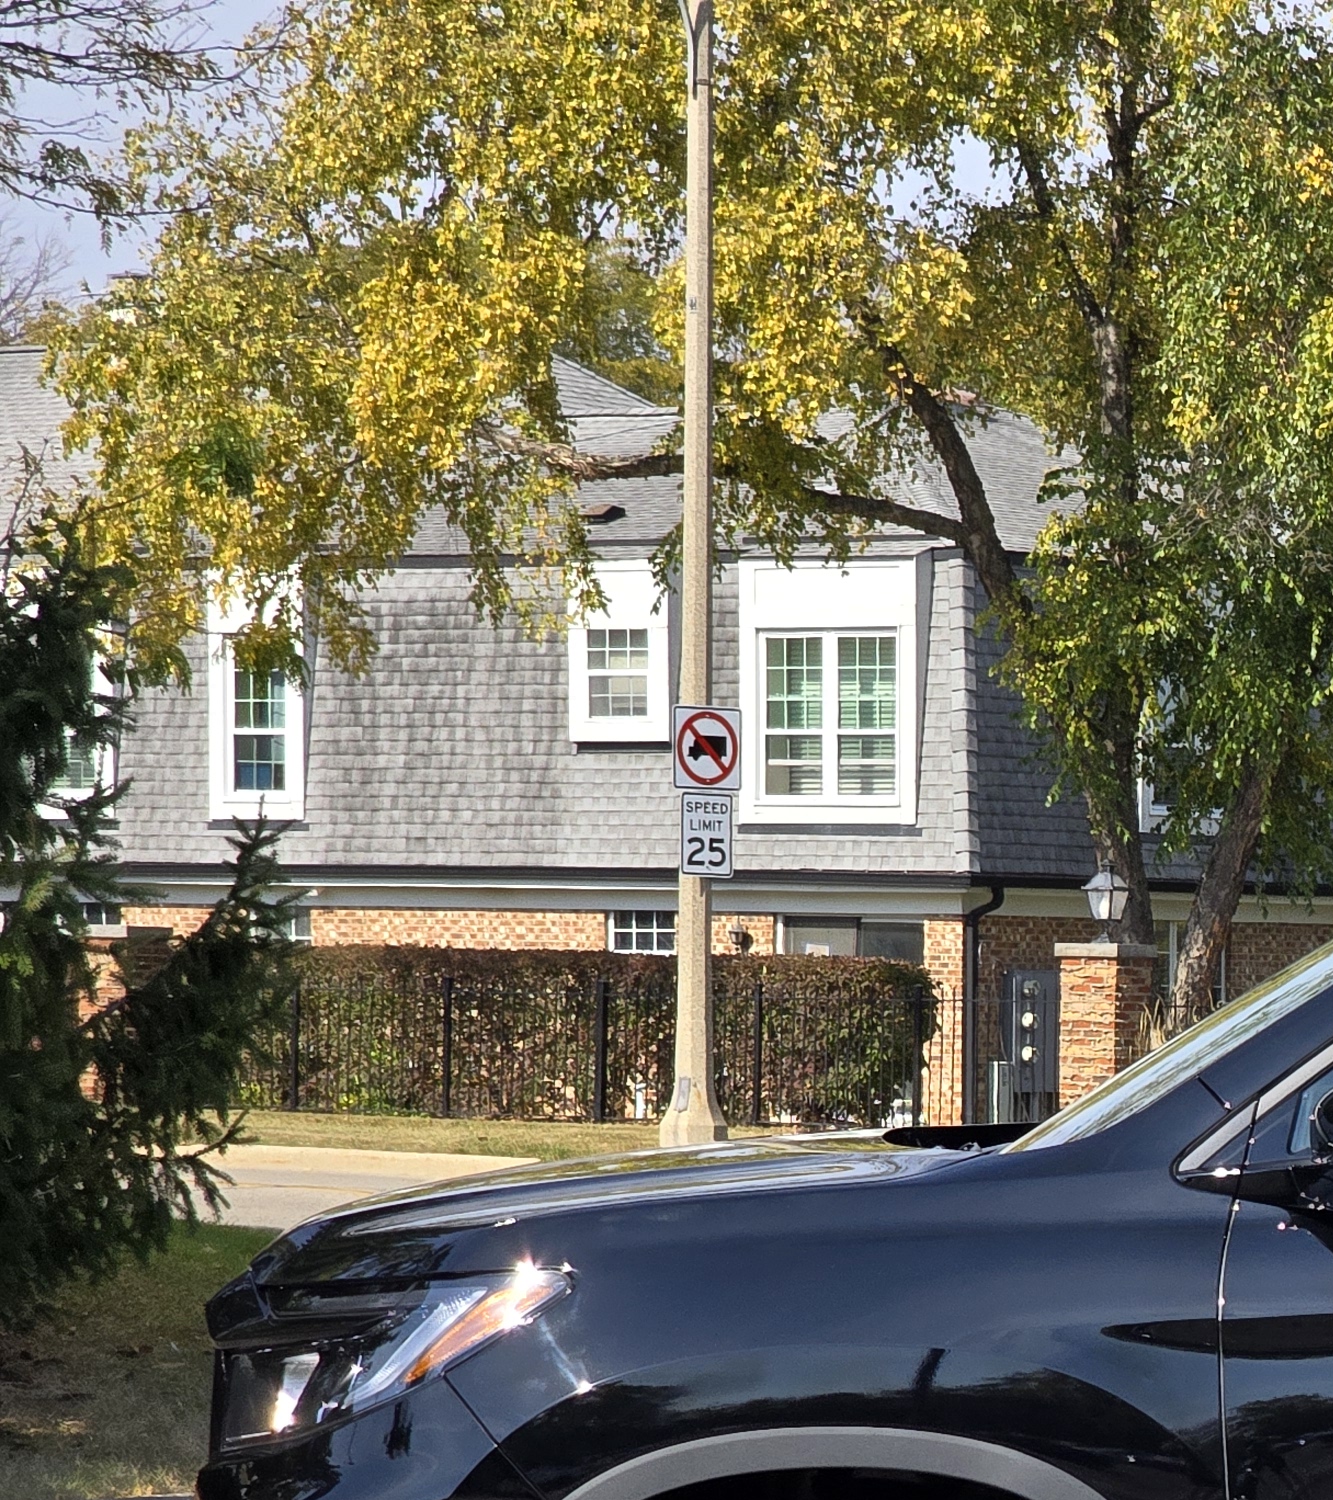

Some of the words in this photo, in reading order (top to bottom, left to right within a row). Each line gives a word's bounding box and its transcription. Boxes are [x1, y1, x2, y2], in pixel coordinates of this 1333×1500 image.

[685, 801, 729, 815] SPEED
[689, 819, 723, 832] LIMIT
[686, 836, 727, 868] 25
